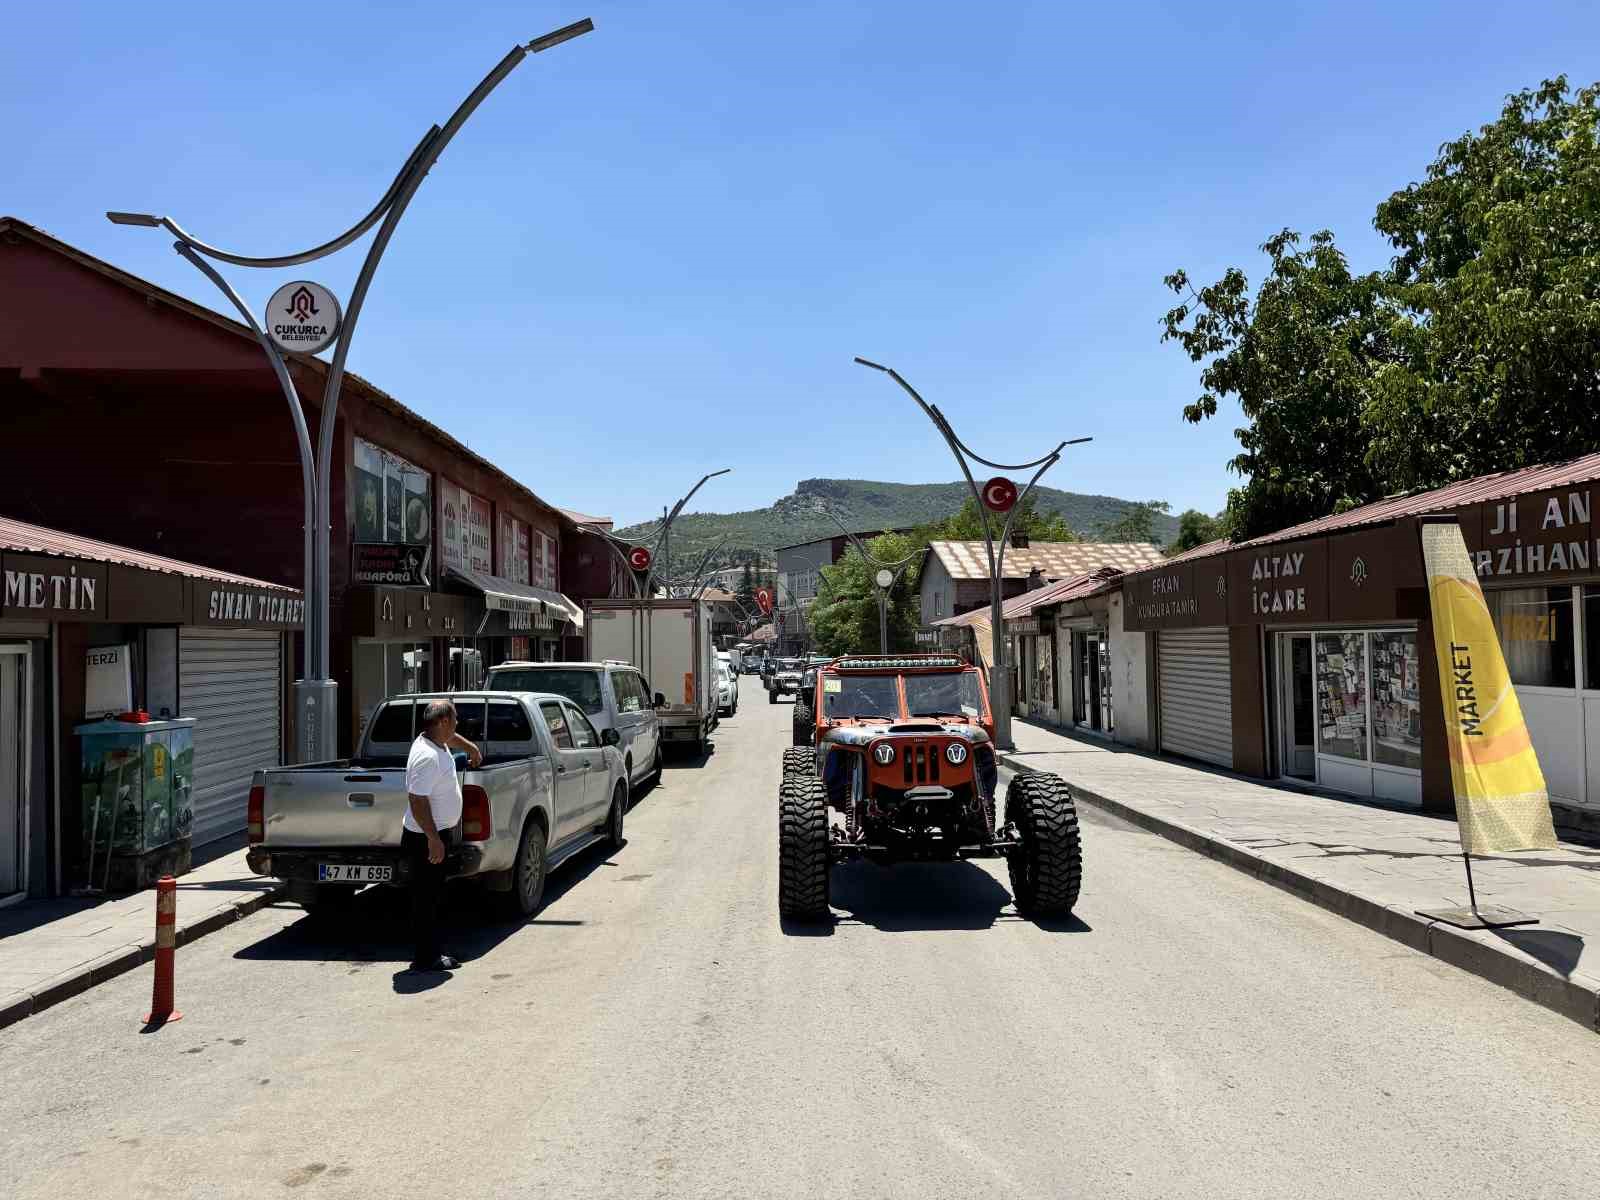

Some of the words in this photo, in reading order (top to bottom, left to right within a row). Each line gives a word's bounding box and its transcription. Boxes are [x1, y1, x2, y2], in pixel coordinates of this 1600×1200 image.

[274, 325, 327, 335] ÇUKURCA
[1252, 552, 1304, 580] ALTAY
[3, 564, 97, 611] METİN
[1152, 576, 1180, 593] EFKAN
[209, 584, 253, 620] SİNAN
[1252, 585, 1305, 614] İCARE
[1450, 641, 1483, 736] MARKET
[327, 866, 340, 879] 47
[368, 866, 390, 880] 695
